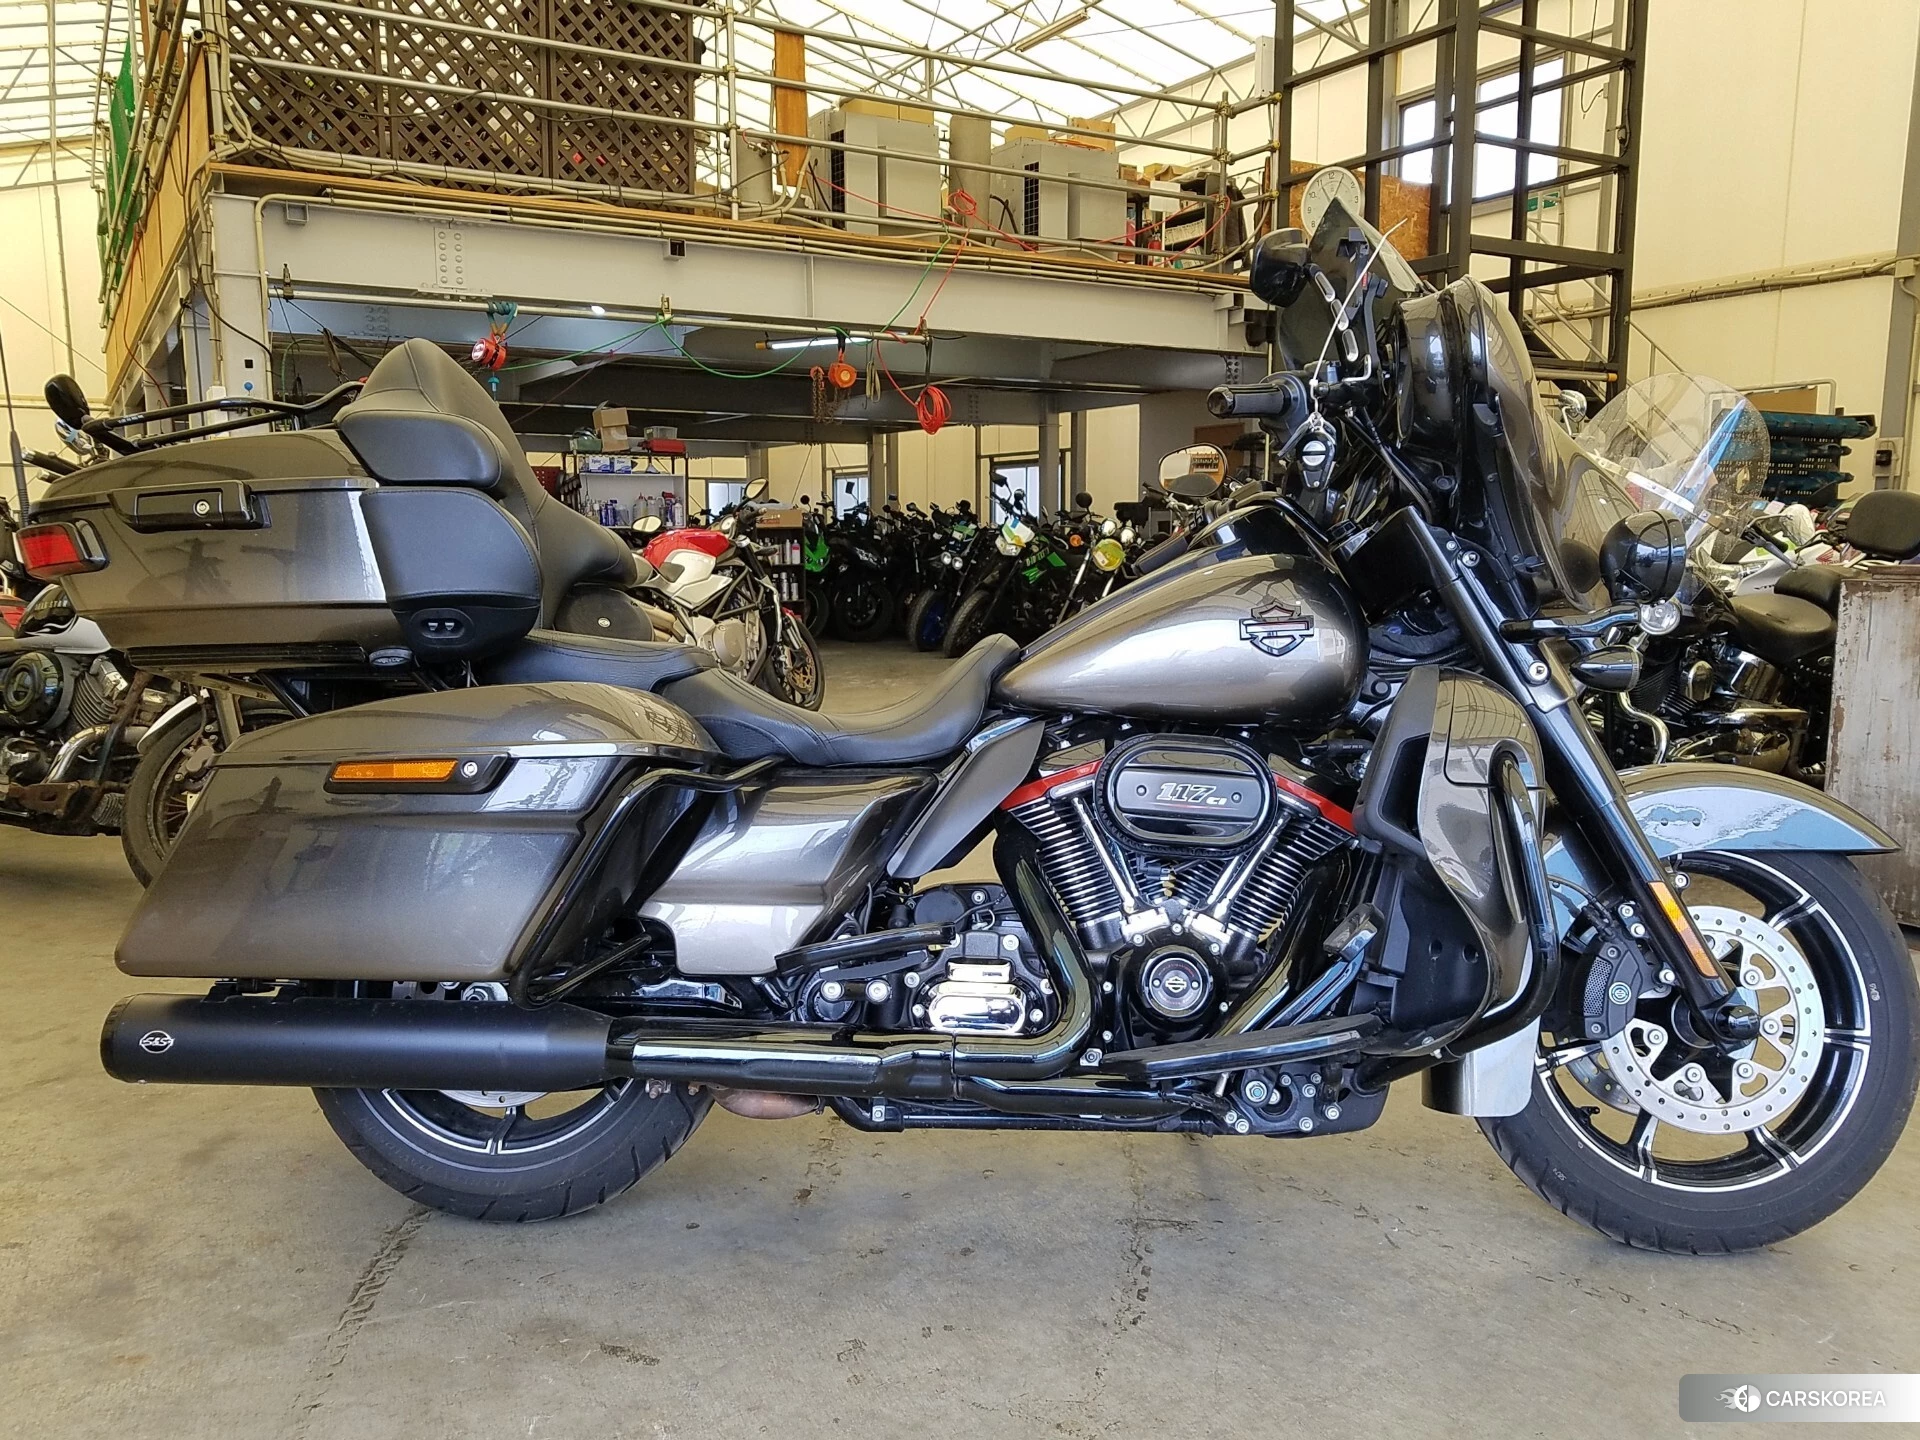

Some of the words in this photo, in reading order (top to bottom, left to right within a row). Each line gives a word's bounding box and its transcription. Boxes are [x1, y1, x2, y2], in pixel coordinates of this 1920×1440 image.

[1328, 171, 1335, 180] 12
[1316, 179, 1323, 187] 11
[1350, 181, 1356, 189] 2
[1308, 191, 1317, 199] 10
[1354, 195, 1359, 204] 3
[1307, 206, 1312, 214] 9
[1311, 220, 1316, 228] 8
[49, 600, 68, 608] STAR
[1156, 782, 1217, 803] 117
